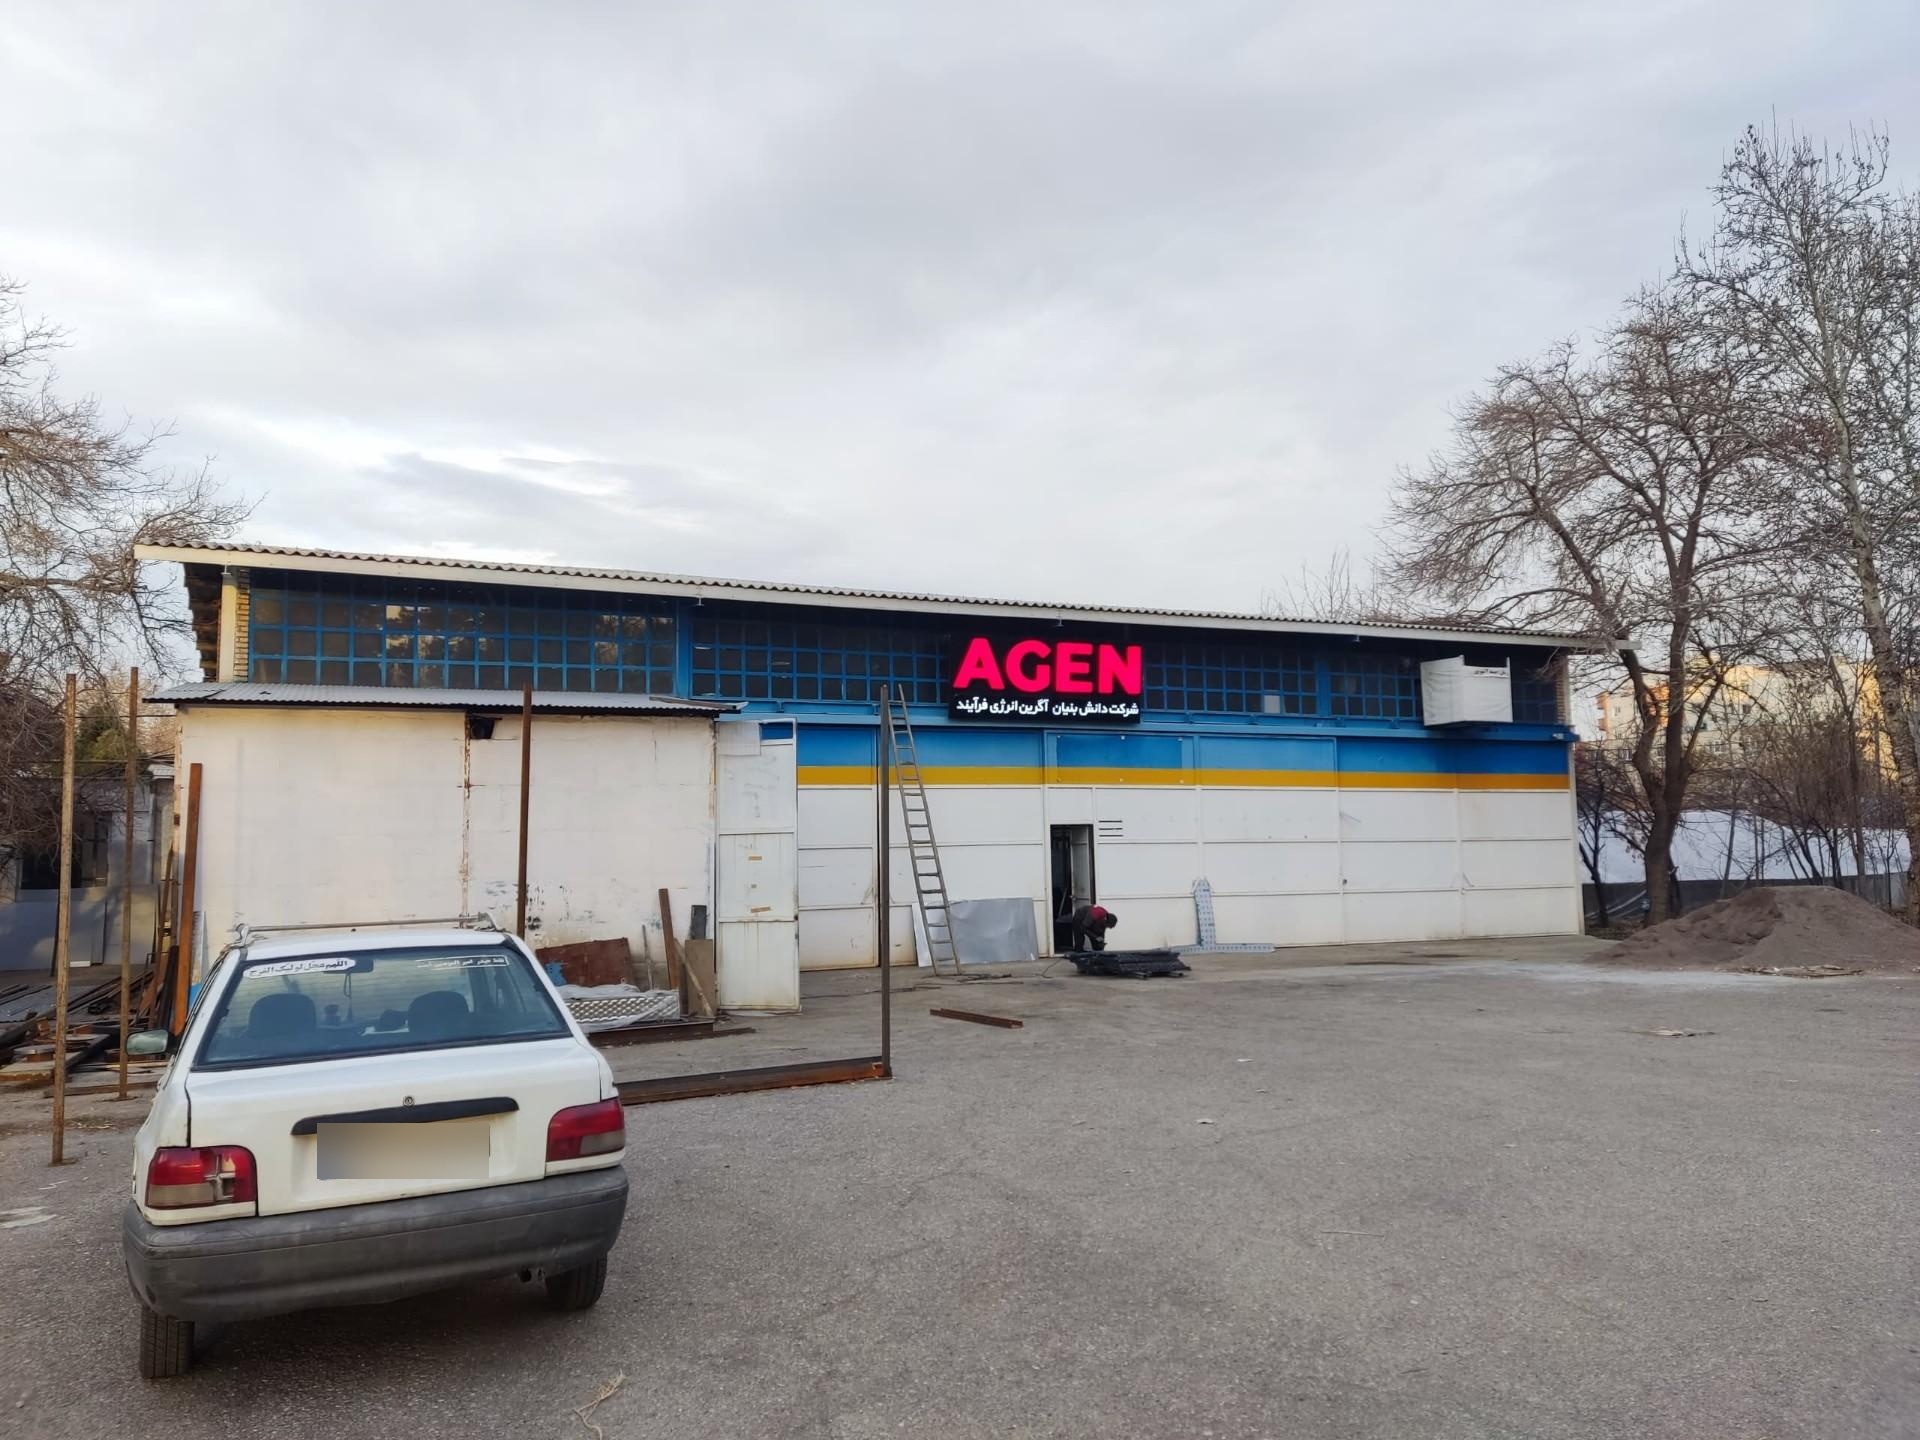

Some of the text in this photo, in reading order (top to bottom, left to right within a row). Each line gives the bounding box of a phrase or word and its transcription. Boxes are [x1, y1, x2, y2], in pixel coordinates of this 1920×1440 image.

[953, 637, 1142, 694] AGEN
[956, 696, 1139, 717] شرکت دانش بنیان آگرین انرژی فرآیند
